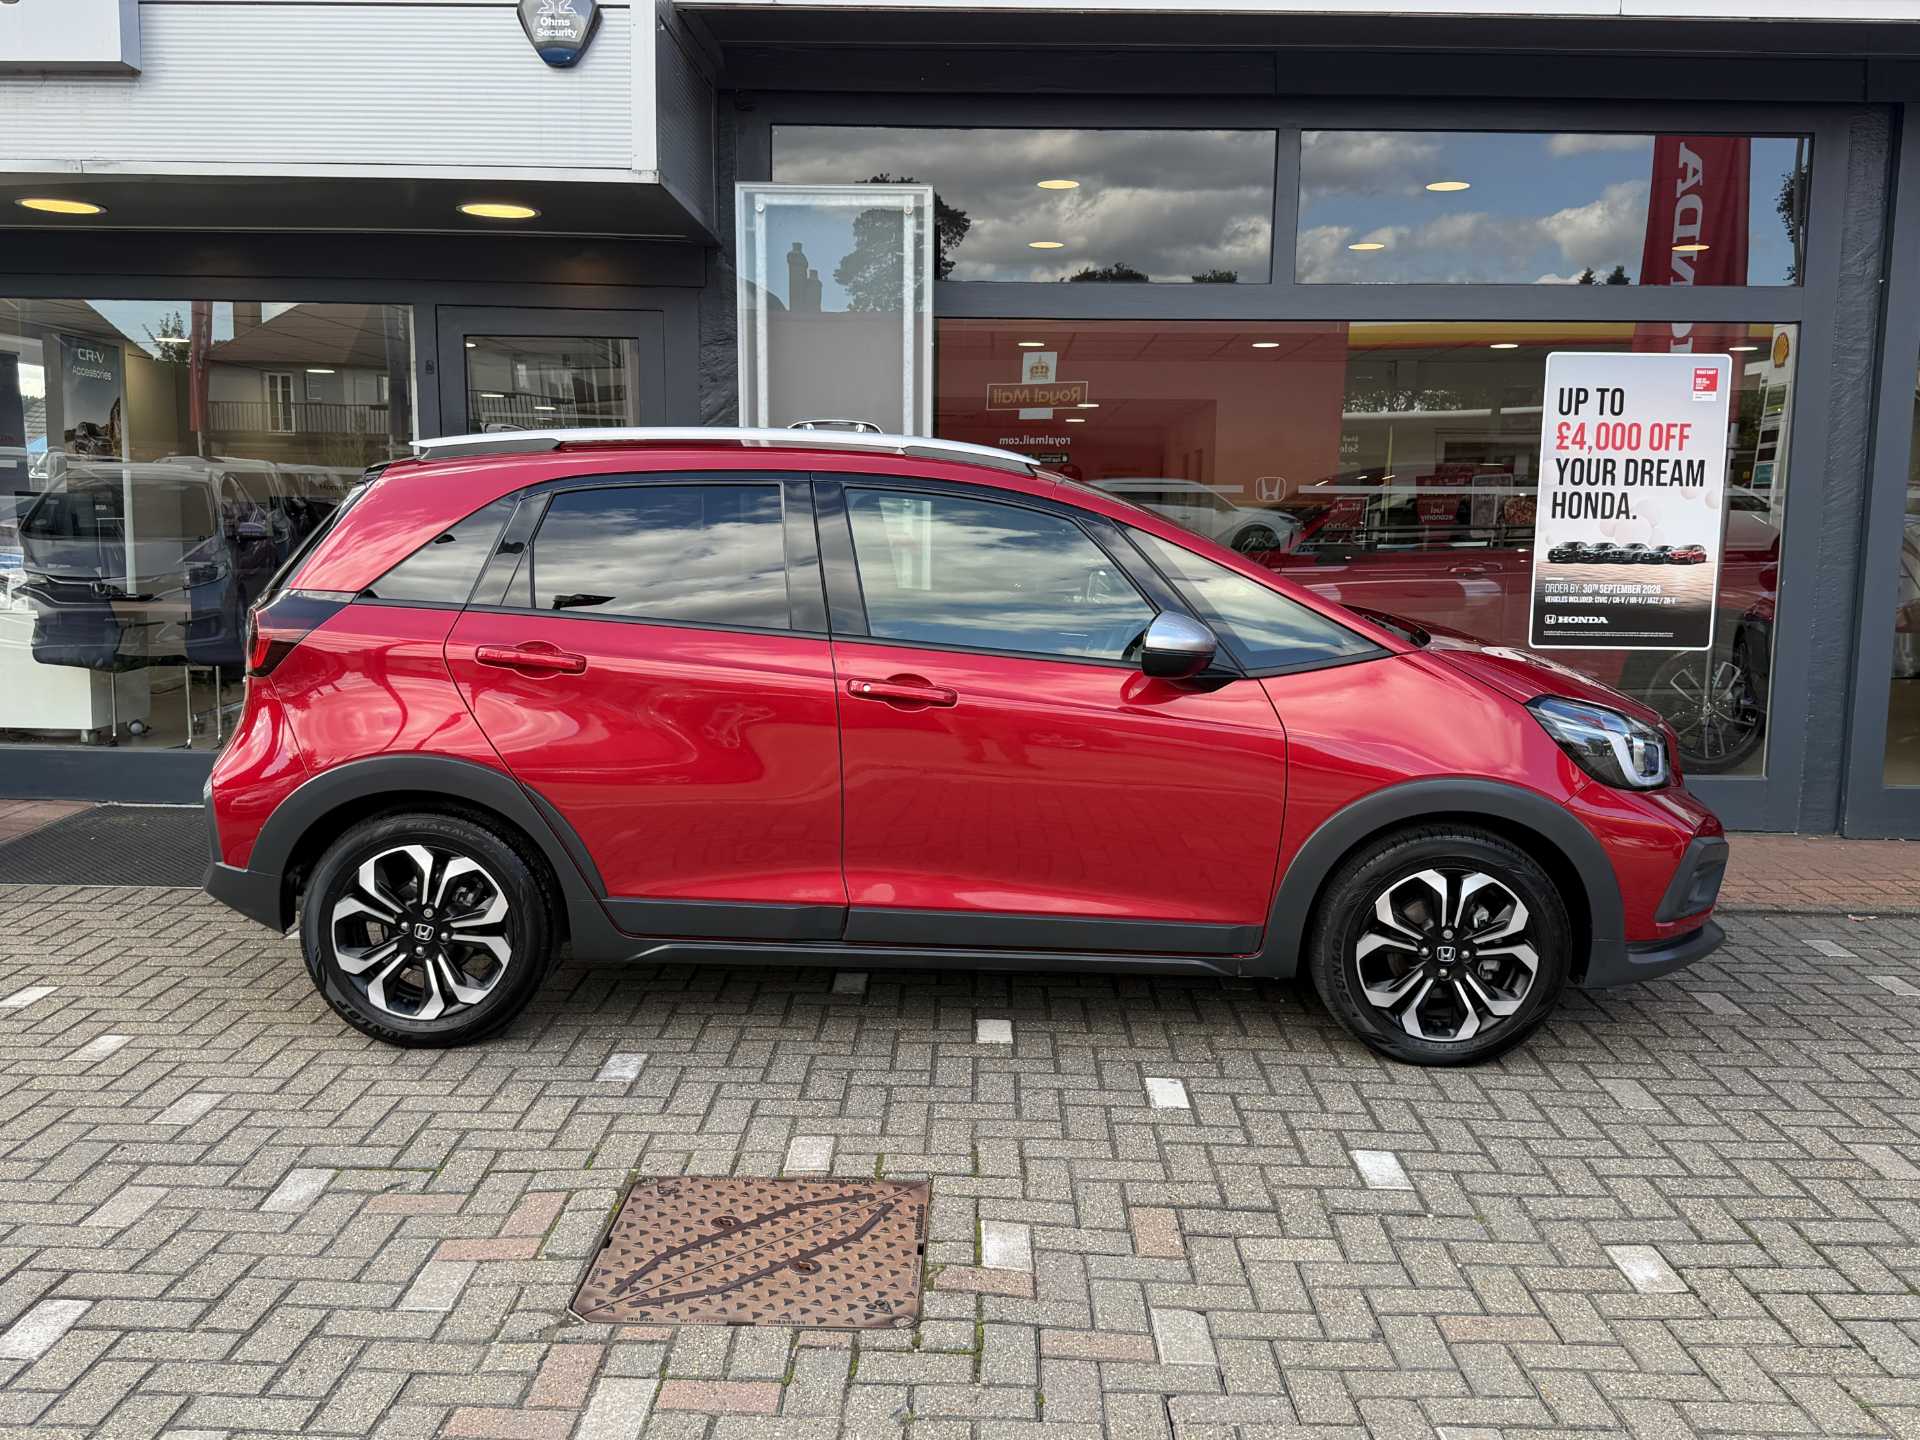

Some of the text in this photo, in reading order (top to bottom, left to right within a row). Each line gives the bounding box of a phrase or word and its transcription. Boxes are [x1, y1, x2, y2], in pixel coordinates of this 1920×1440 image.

[540, 17, 570, 26] Ohms
[536, 28, 578, 38] Security
[72, 365, 112, 381] Accessories
[1558, 387, 1625, 416] UP TO
[1556, 422, 1692, 455] £4,000 OFF
[1556, 458, 1705, 487] YOUR DREAM
[1551, 491, 1637, 520] HONDA.
[1545, 584, 1568, 593] ORDER
[1600, 584, 1641, 594] SEPTEMBER
[1557, 616, 1609, 624] HONDA
